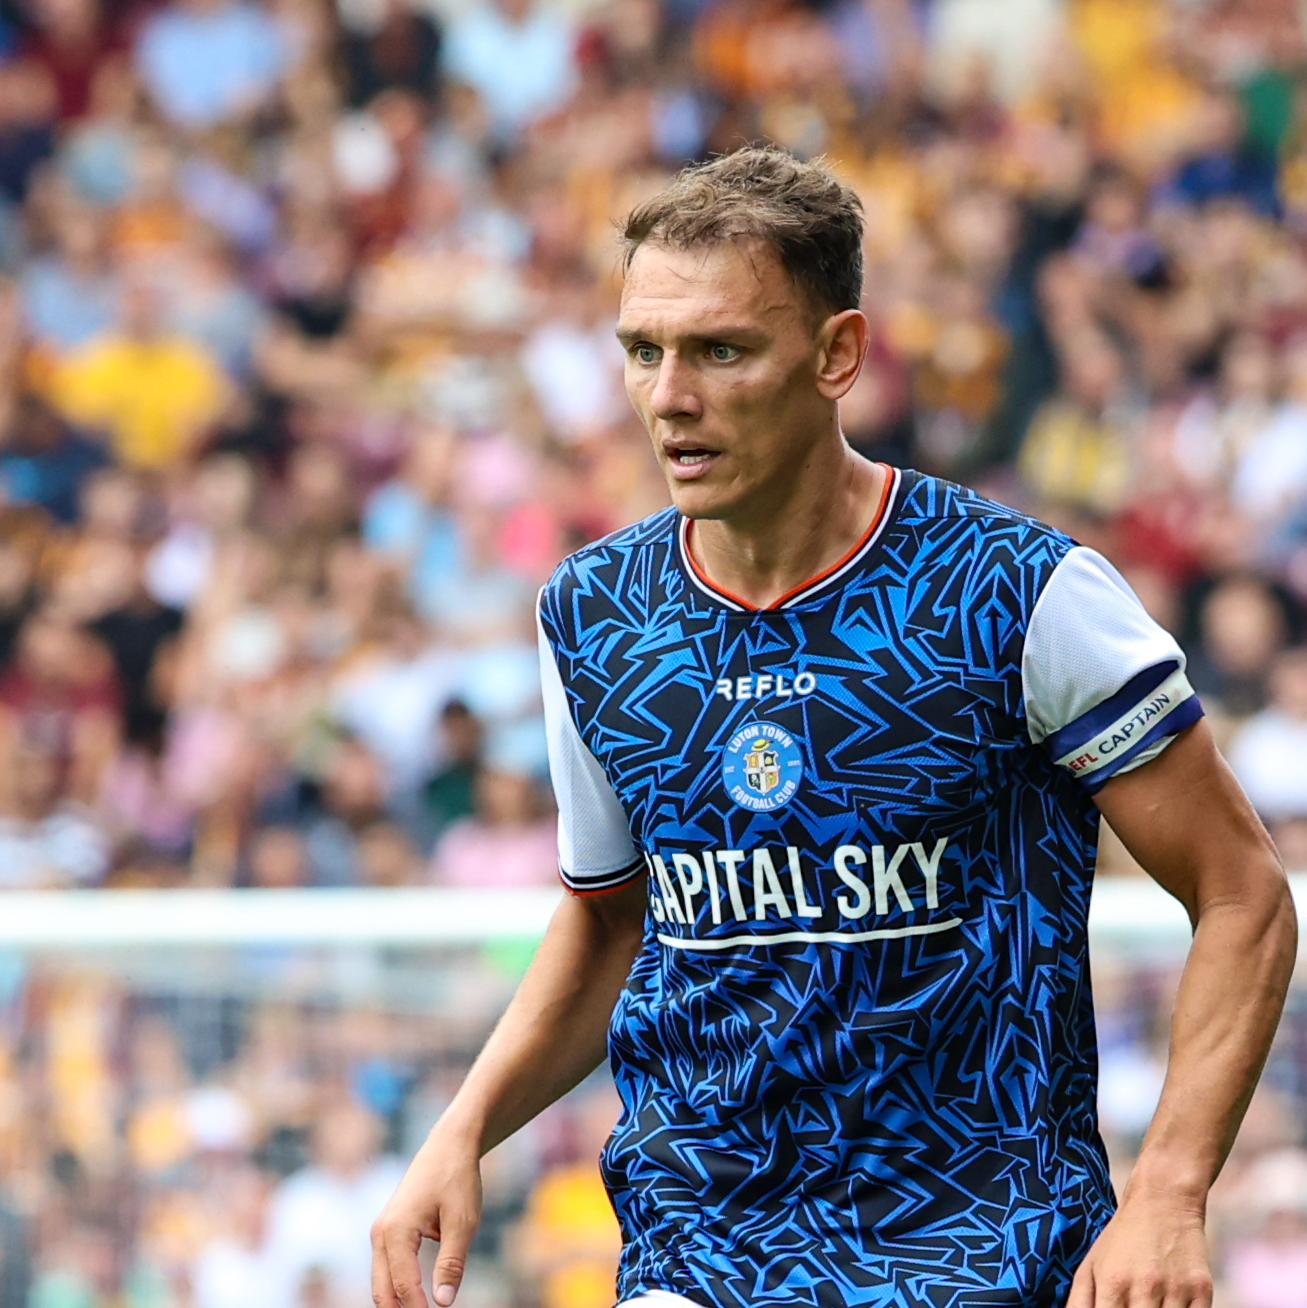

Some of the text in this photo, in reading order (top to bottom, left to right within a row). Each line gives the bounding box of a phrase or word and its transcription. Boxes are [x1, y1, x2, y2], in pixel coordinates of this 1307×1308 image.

[716, 671, 816, 701] REFLO
[727, 725, 793, 753] LUTON TOWN
[1068, 693, 1171, 772] EFL CAPTAIN
[731, 779, 796, 809] FOOTBALL CLUB
[833, 837, 949, 919] SKY
